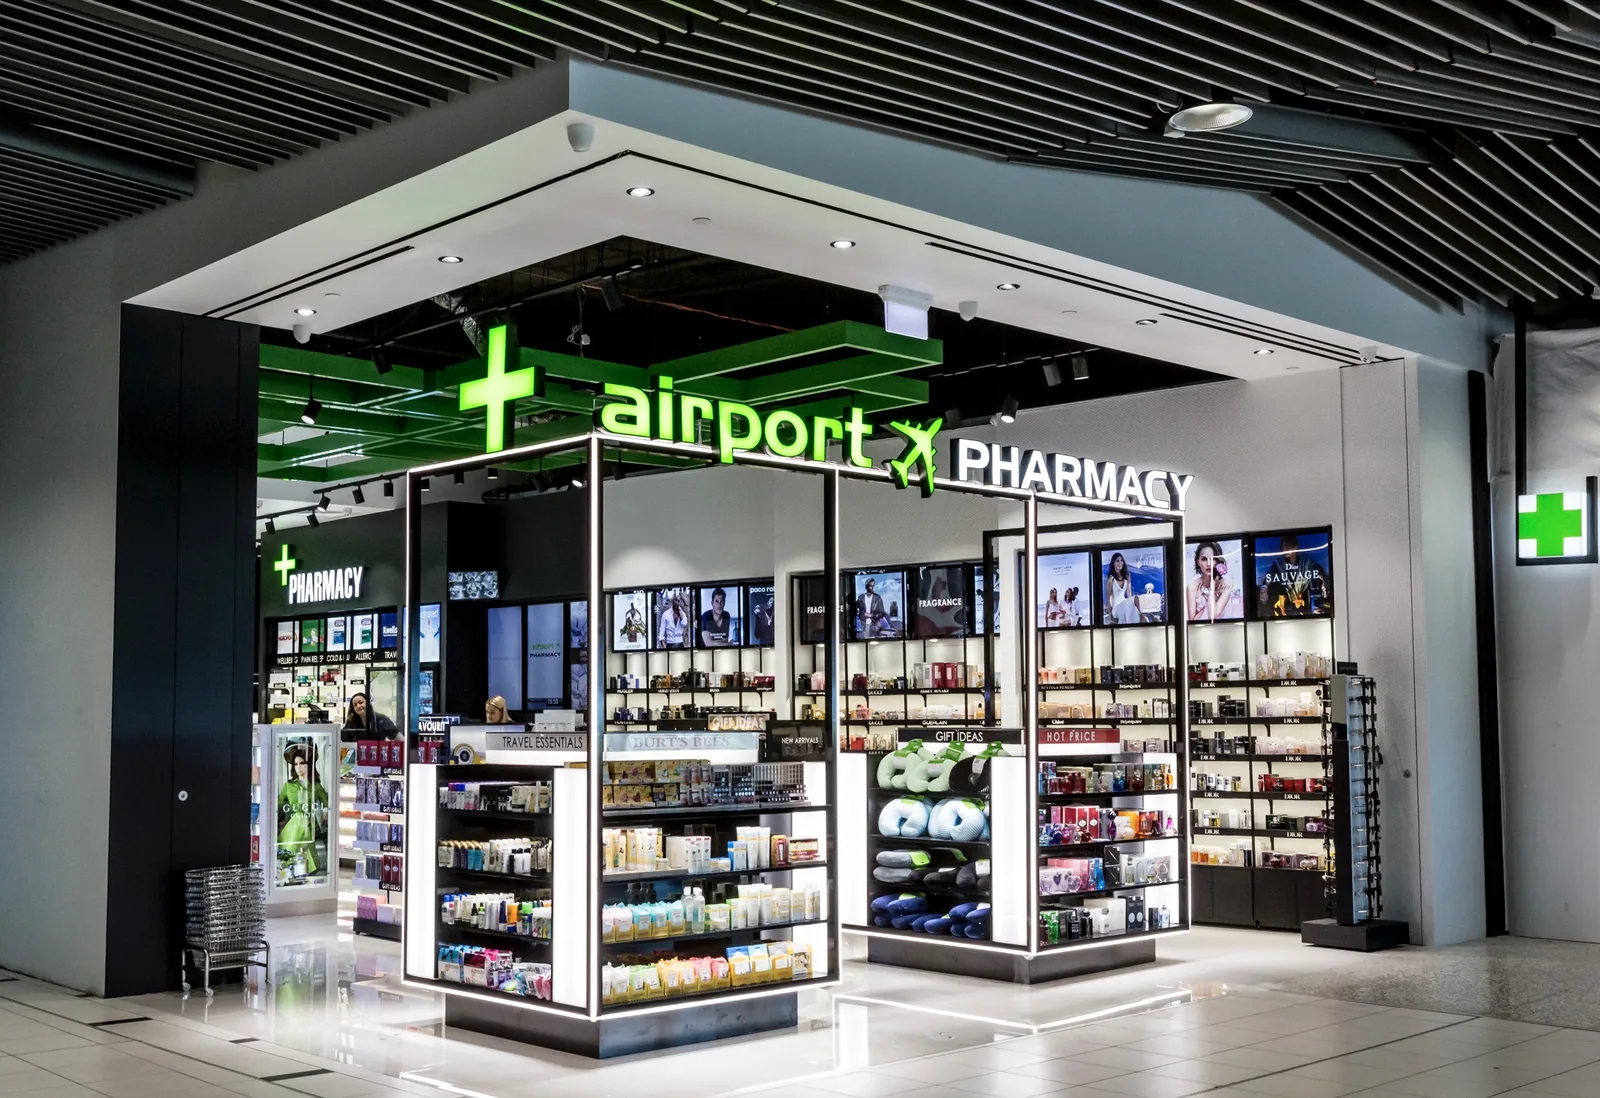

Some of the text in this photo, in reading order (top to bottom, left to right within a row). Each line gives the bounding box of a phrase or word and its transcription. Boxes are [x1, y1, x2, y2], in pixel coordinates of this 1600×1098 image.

[600, 375, 873, 464] airport
[957, 438, 1195, 512] PHARMACY
[1285, 563, 1299, 571] Dior
[1265, 569, 1320, 583] SAUVAGE
[288, 566, 363, 605] PHARMACY
[918, 597, 962, 608] FRAGRANCE
[327, 654, 338, 662] COLD
[633, 736, 731, 748] BURT'S BEES
[794, 736, 819, 744] ARRIVALS
[935, 731, 984, 742] GIFT IDEAS
[1046, 731, 1096, 742] HOT PRICE
[502, 736, 583, 749] TRAVEL ESSENTIALS
[283, 803, 324, 813] GUCCI
